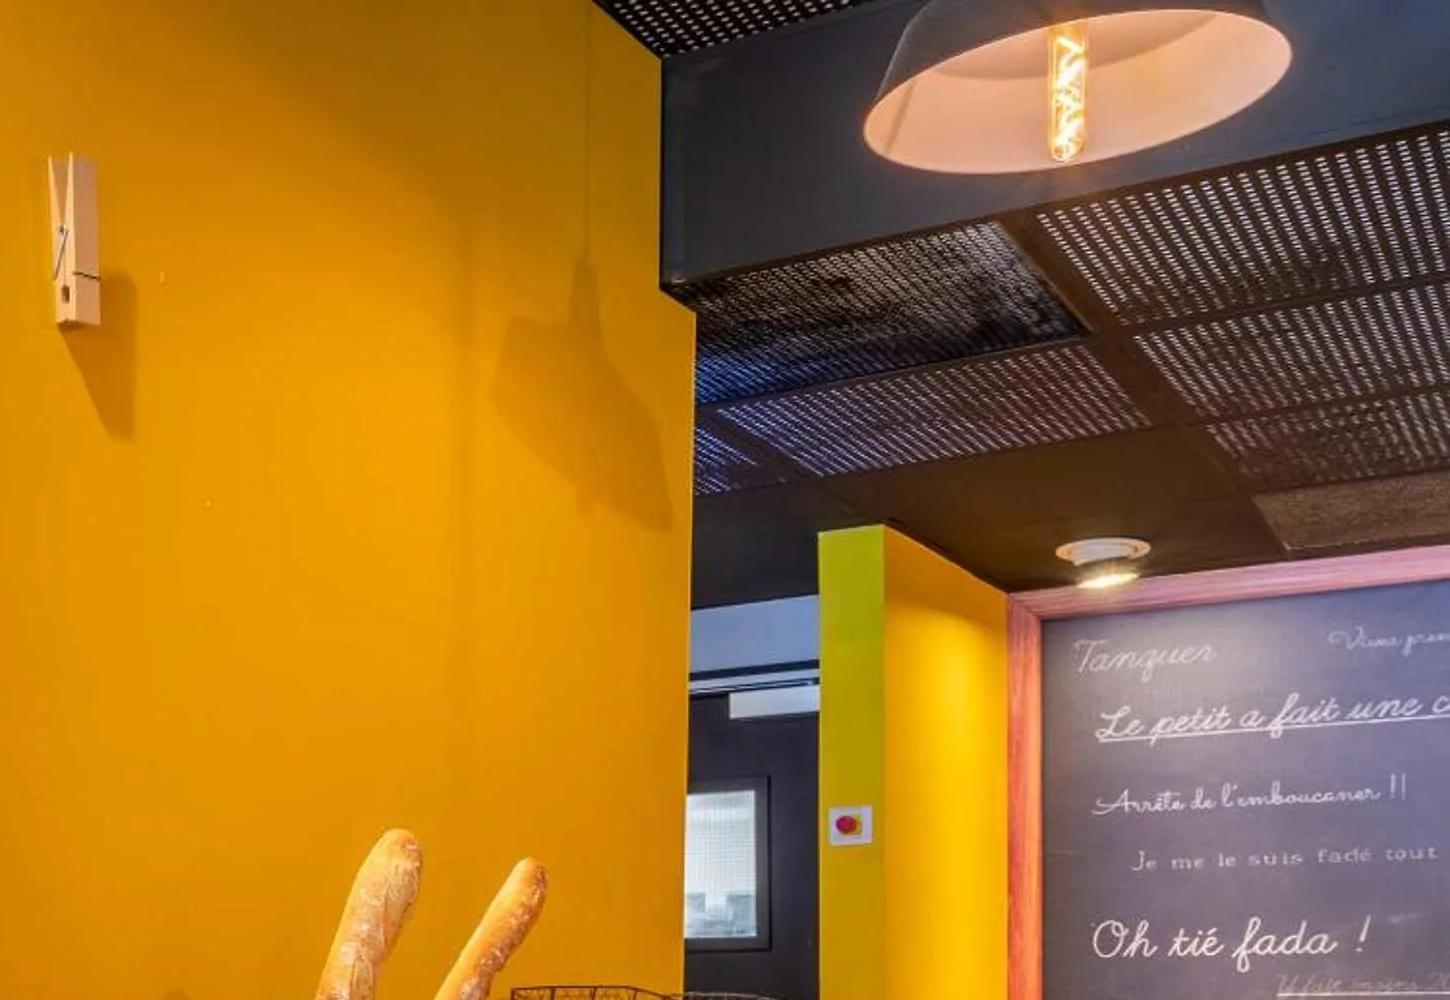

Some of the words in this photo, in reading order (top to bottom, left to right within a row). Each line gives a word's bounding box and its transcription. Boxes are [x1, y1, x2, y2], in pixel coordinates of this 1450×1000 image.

[1073, 638, 1217, 683] Tanquer
[1094, 705, 1145, 739] Le
[1149, 704, 1233, 747] petit
[1239, 708, 1267, 727] a
[1268, 692, 1340, 740] fait
[1345, 697, 1425, 720] une
[1190, 786, 1218, 810] de
[1131, 850, 1158, 871] Je
[1218, 852, 1237, 868] le
[1386, 846, 1440, 862] tout
[1093, 919, 1158, 959] Oh
[1167, 926, 1226, 958] tié
[1232, 916, 1339, 973] fada
